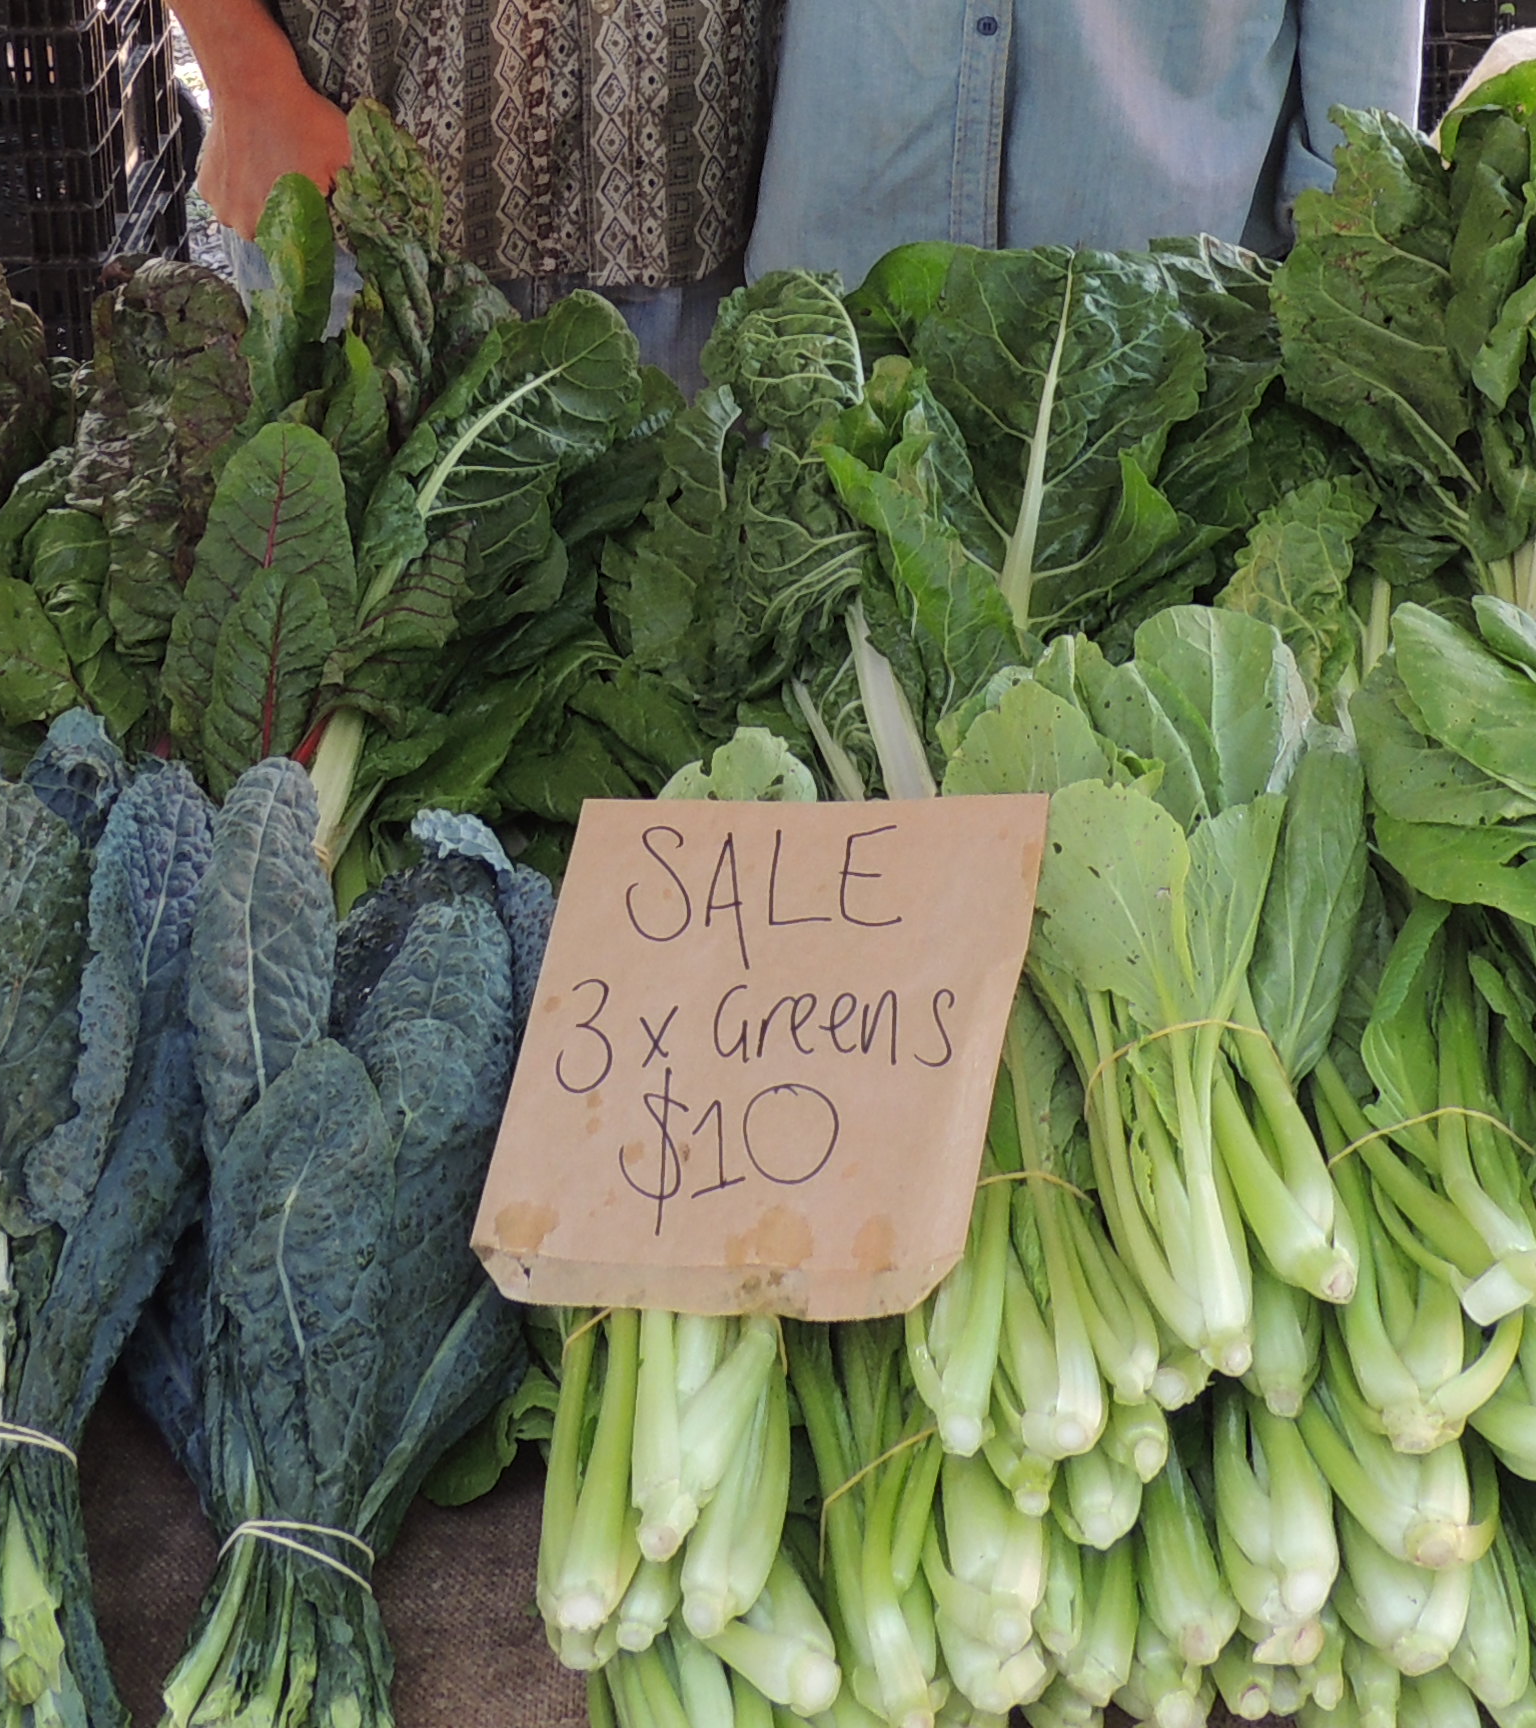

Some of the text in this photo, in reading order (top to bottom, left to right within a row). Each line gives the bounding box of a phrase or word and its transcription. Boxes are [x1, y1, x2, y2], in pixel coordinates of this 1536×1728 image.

[626, 825, 903, 969] SALE
[713, 984, 955, 1068] Greens
[618, 1067, 840, 1236] $10
